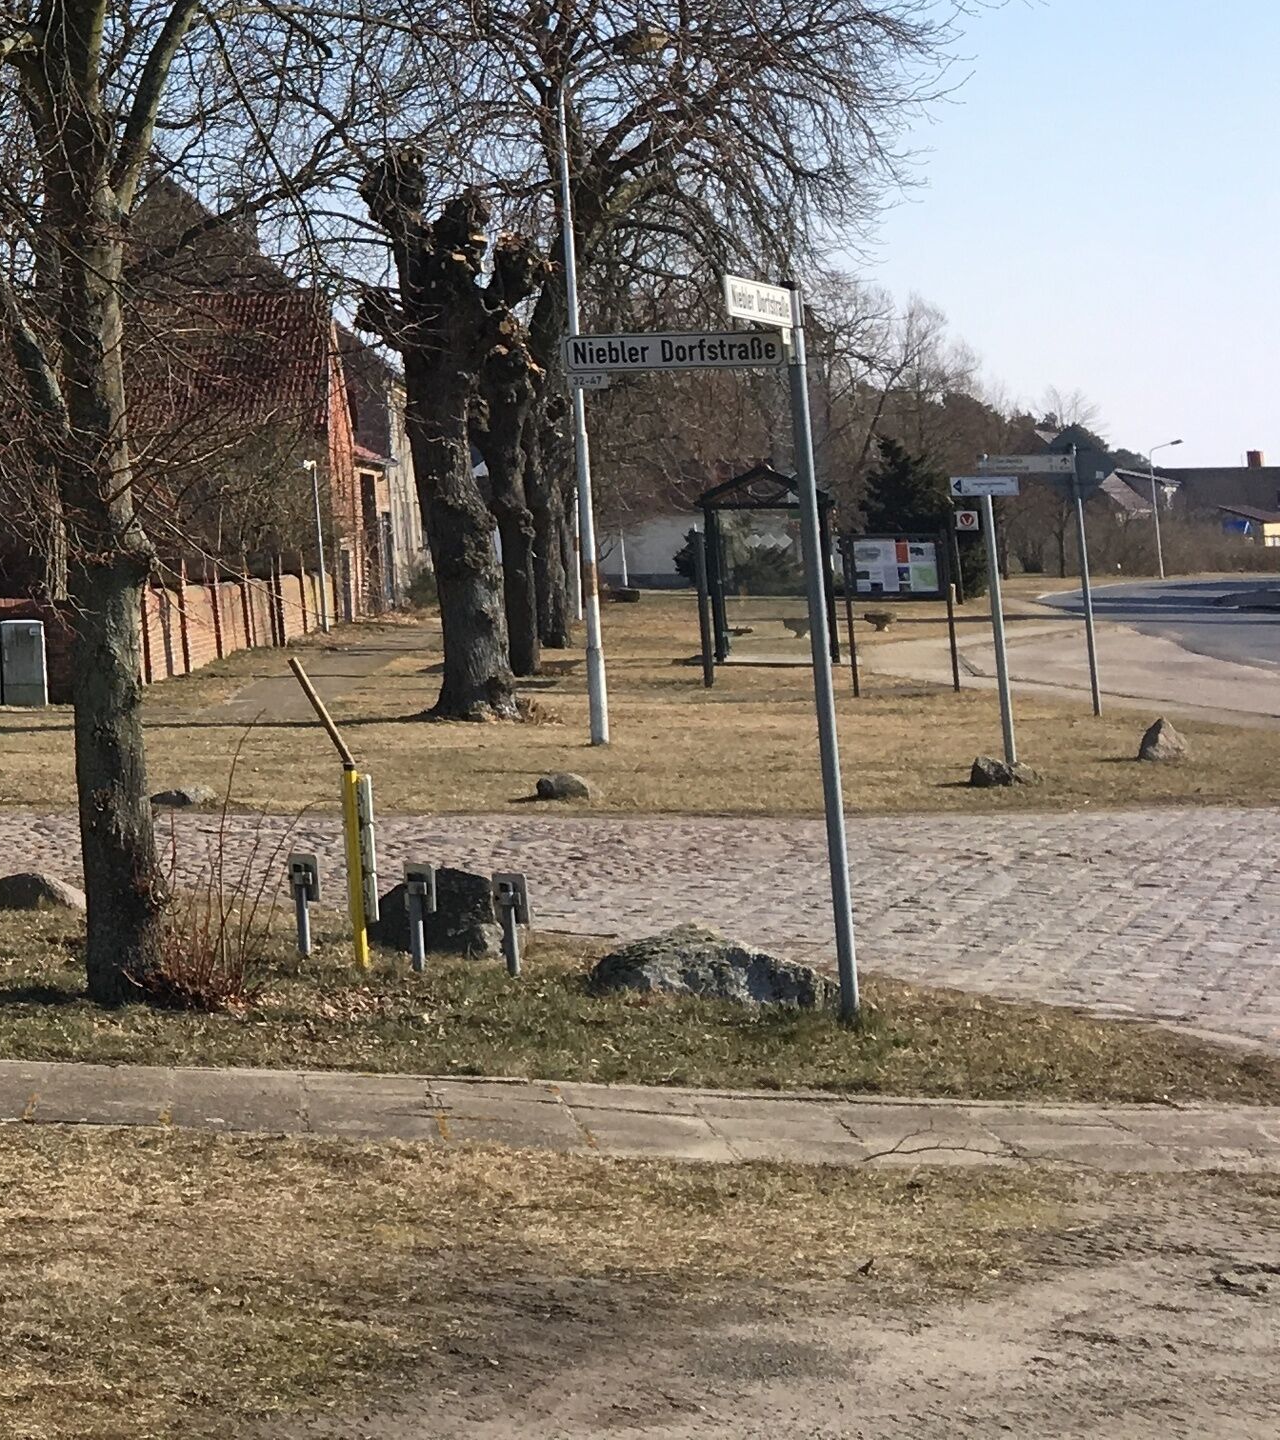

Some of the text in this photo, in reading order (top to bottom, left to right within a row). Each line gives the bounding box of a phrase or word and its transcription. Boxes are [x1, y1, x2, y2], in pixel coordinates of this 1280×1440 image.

[731, 284, 791, 319] Niebler Dorfstraße
[573, 337, 776, 364] Niebler Dorfstraße
[573, 375, 602, 386] 32-47
